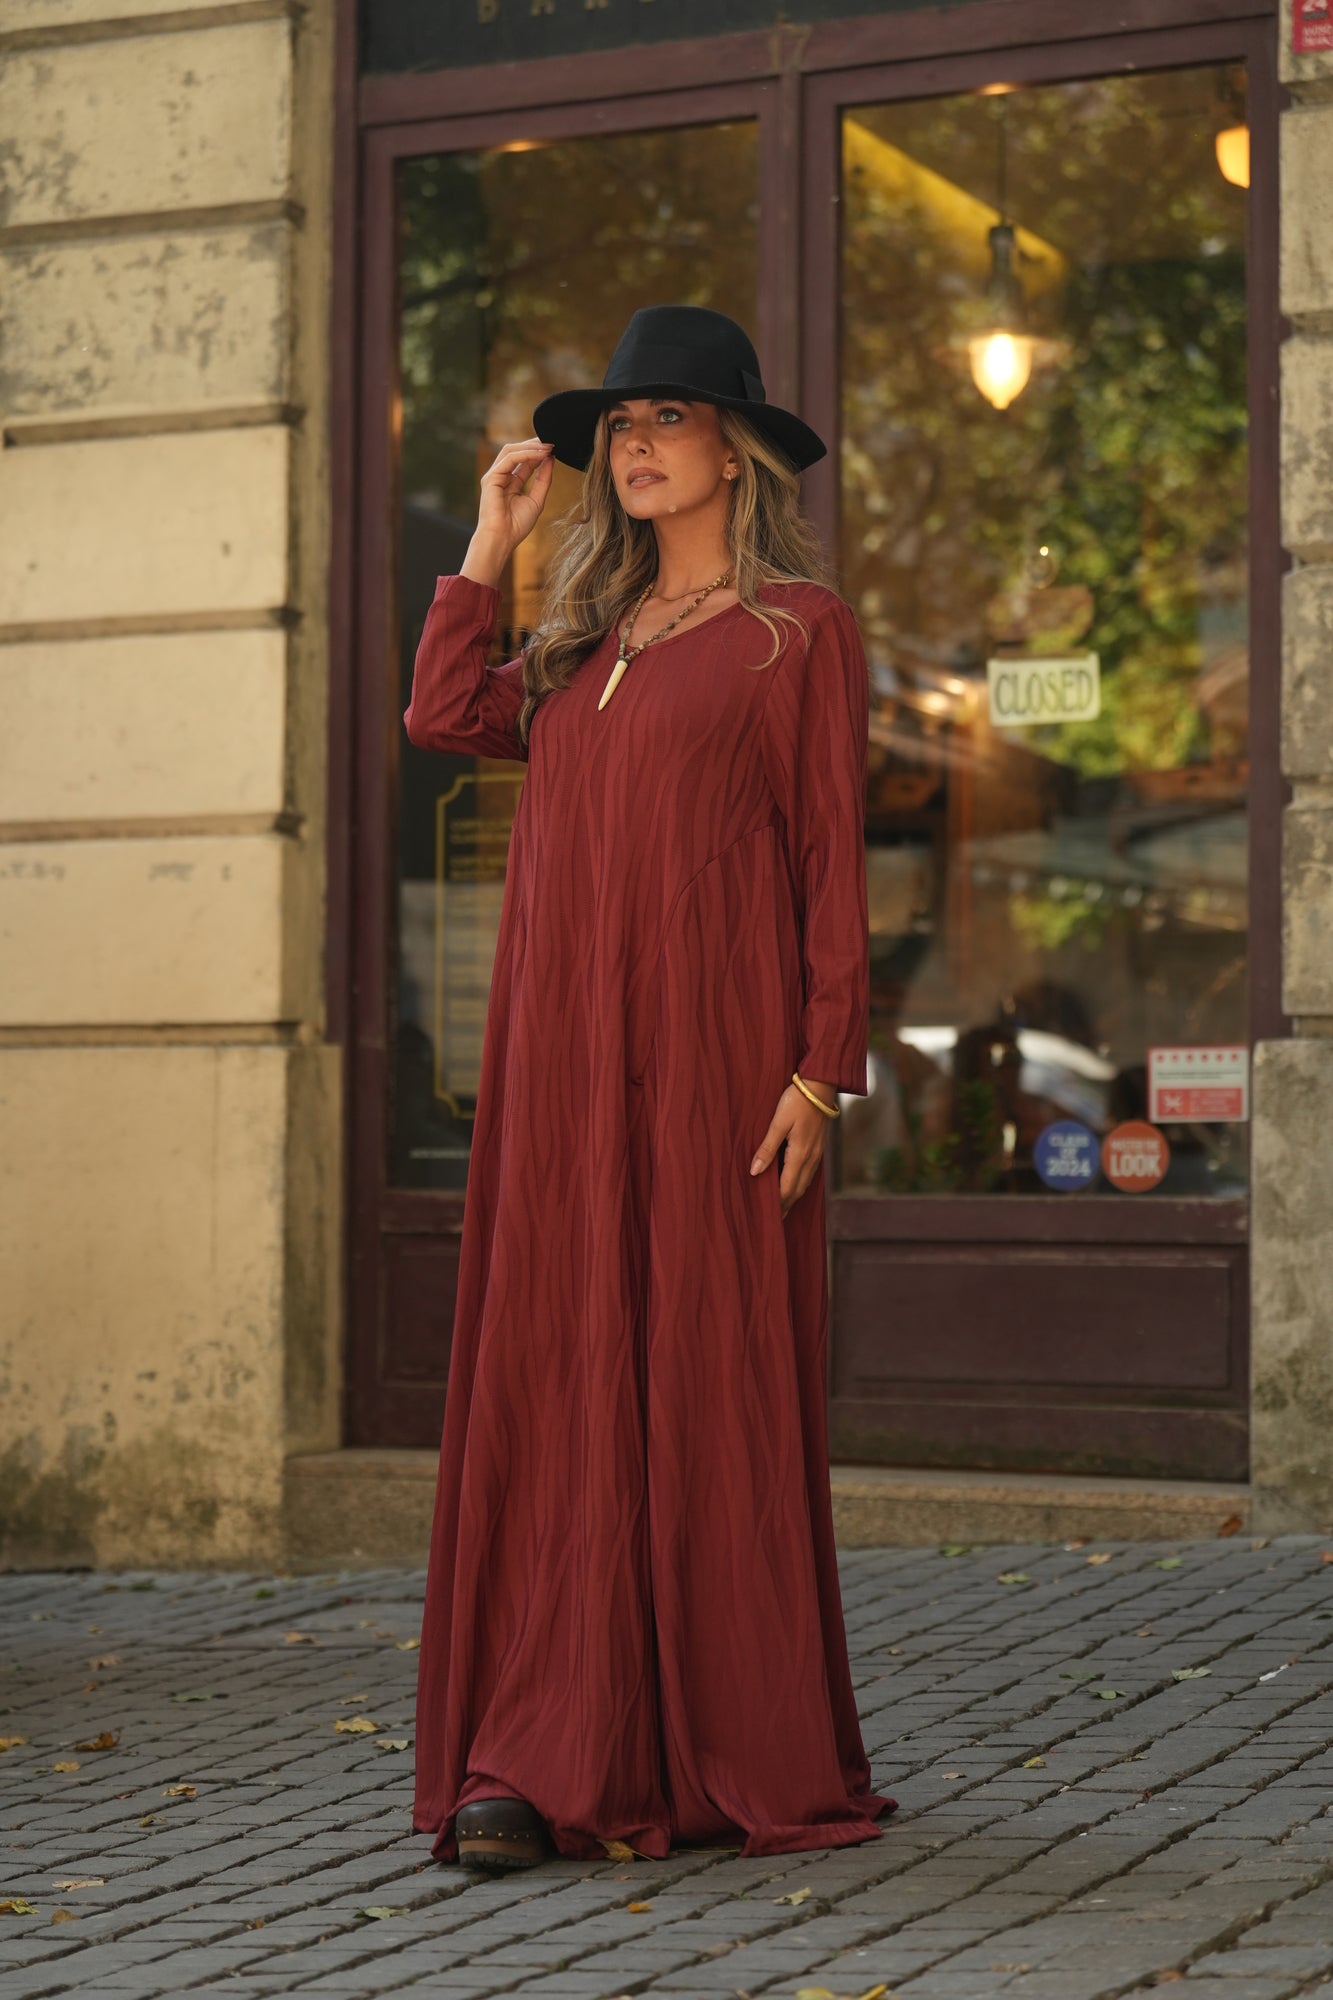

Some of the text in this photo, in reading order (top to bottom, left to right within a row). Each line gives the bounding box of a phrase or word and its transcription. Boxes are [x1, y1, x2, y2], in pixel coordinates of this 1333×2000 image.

[994, 668, 1094, 716] CLOSED
[1046, 1158, 1090, 1177] 2024
[1110, 1154, 1160, 1177] LOOK
